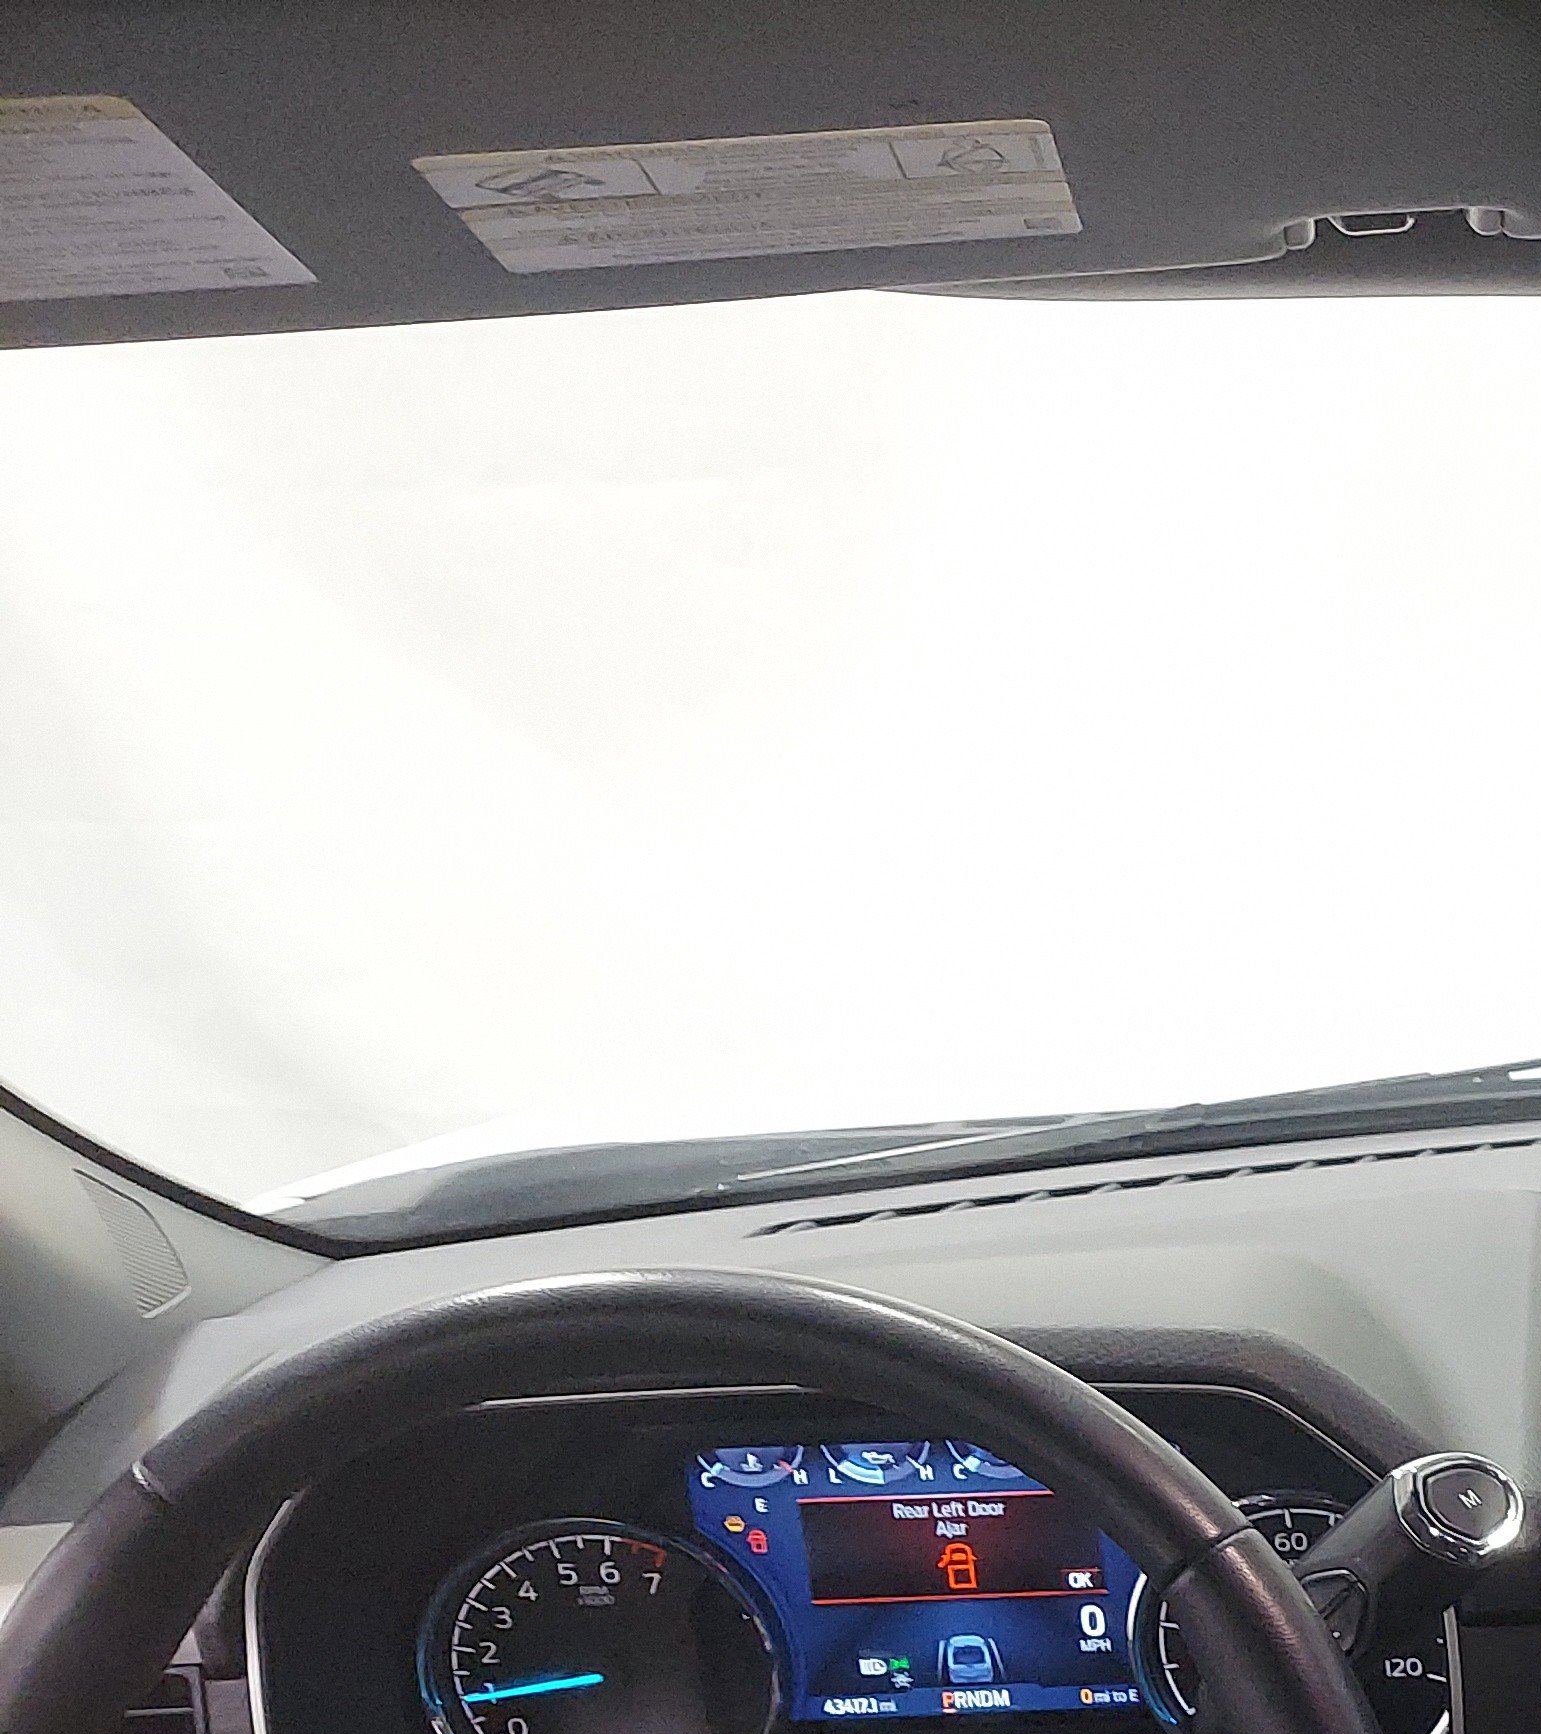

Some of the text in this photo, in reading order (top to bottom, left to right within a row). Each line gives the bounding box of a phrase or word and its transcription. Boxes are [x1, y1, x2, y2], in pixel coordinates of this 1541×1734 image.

[793, 1469, 808, 1484] H
[828, 1467, 843, 1484] L
[919, 1465, 934, 1481] H
[755, 1497, 769, 1513] E
[1458, 1488, 1483, 1509] M
[892, 1500, 1005, 1519] Rear Left Door
[936, 1521, 968, 1539] Ajar
[1274, 1532, 1309, 1552] 60
[557, 1562, 578, 1586] 5
[599, 1561, 621, 1585] 6
[1068, 1572, 1094, 1588] OK
[517, 1580, 539, 1602] 4
[641, 1572, 662, 1595] 7
[491, 1606, 513, 1629] 3
[1081, 1604, 1106, 1637] 0
[478, 1641, 501, 1664] 2
[1079, 1638, 1112, 1653] MPH
[1384, 1657, 1424, 1678] 120
[942, 1688, 1011, 1709] PRNDM
[1080, 1688, 1139, 1704] 0 mi to E
